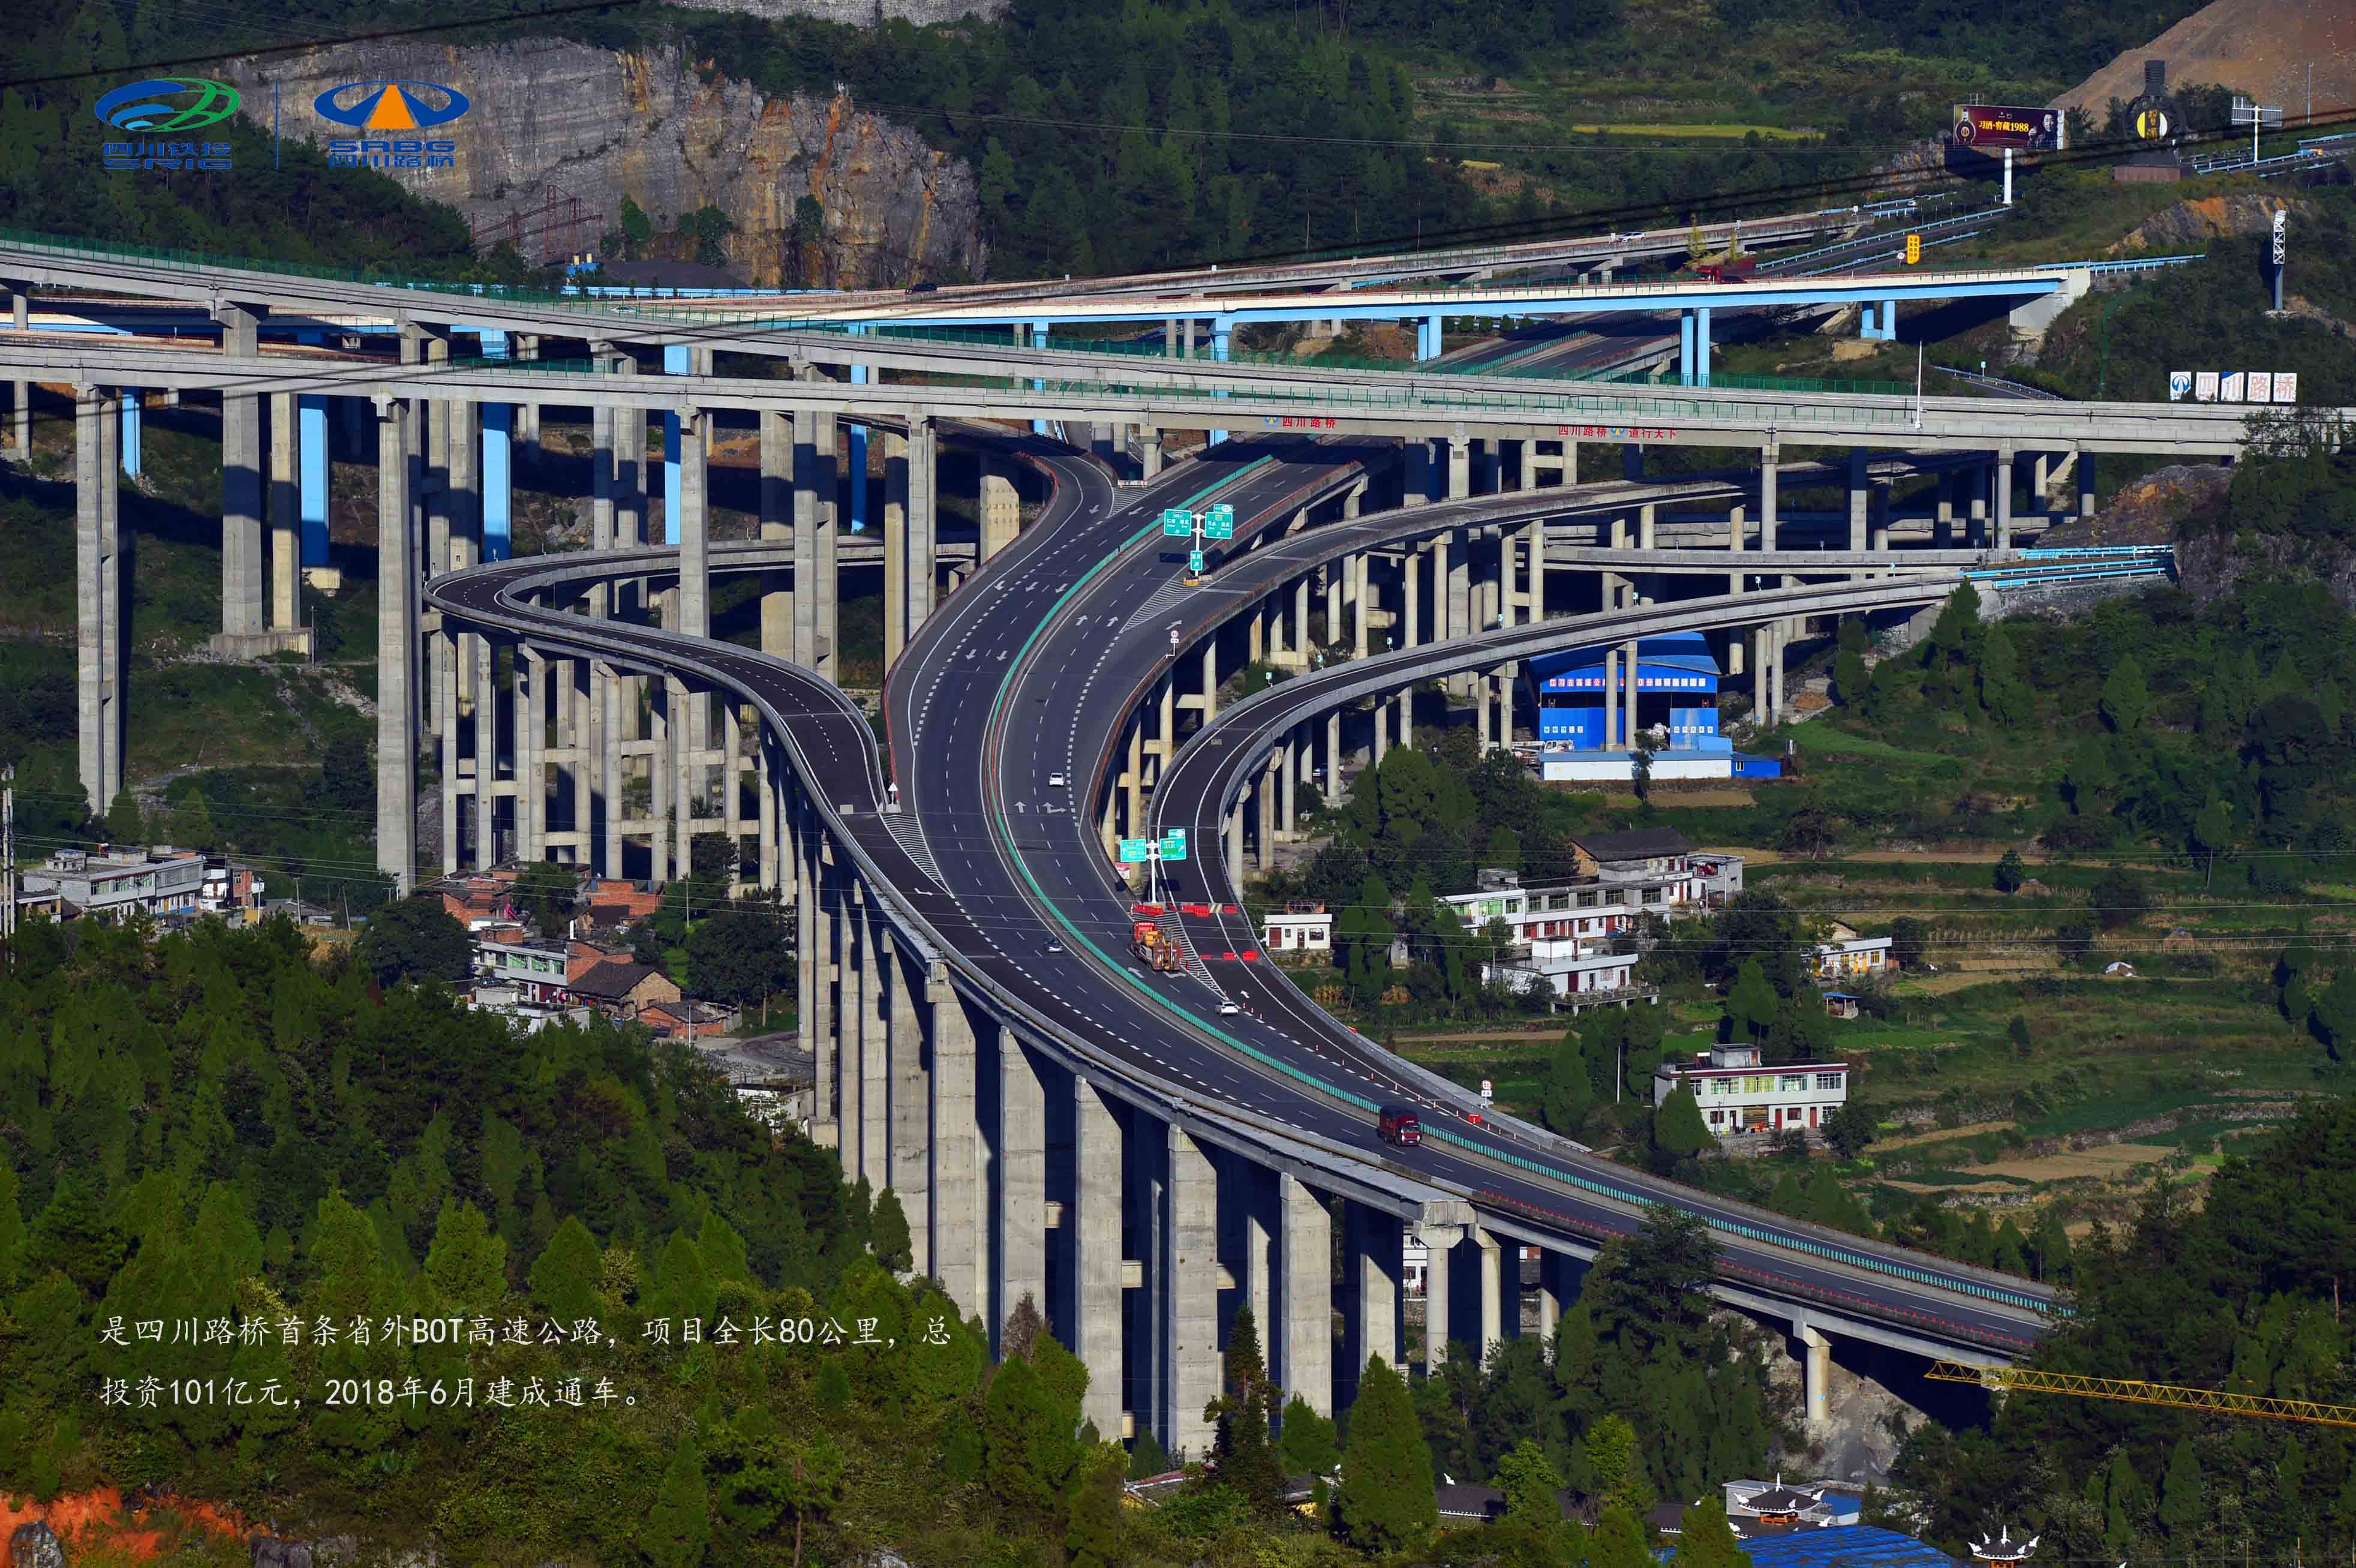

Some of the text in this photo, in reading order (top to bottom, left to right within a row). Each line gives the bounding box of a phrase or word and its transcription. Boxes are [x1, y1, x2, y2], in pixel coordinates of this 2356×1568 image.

[2199, 376, 2295, 399] 四川路桥
[1282, 417, 1335, 428] 四川路桥
[1559, 425, 1676, 439] 四川路桥 道行天下
